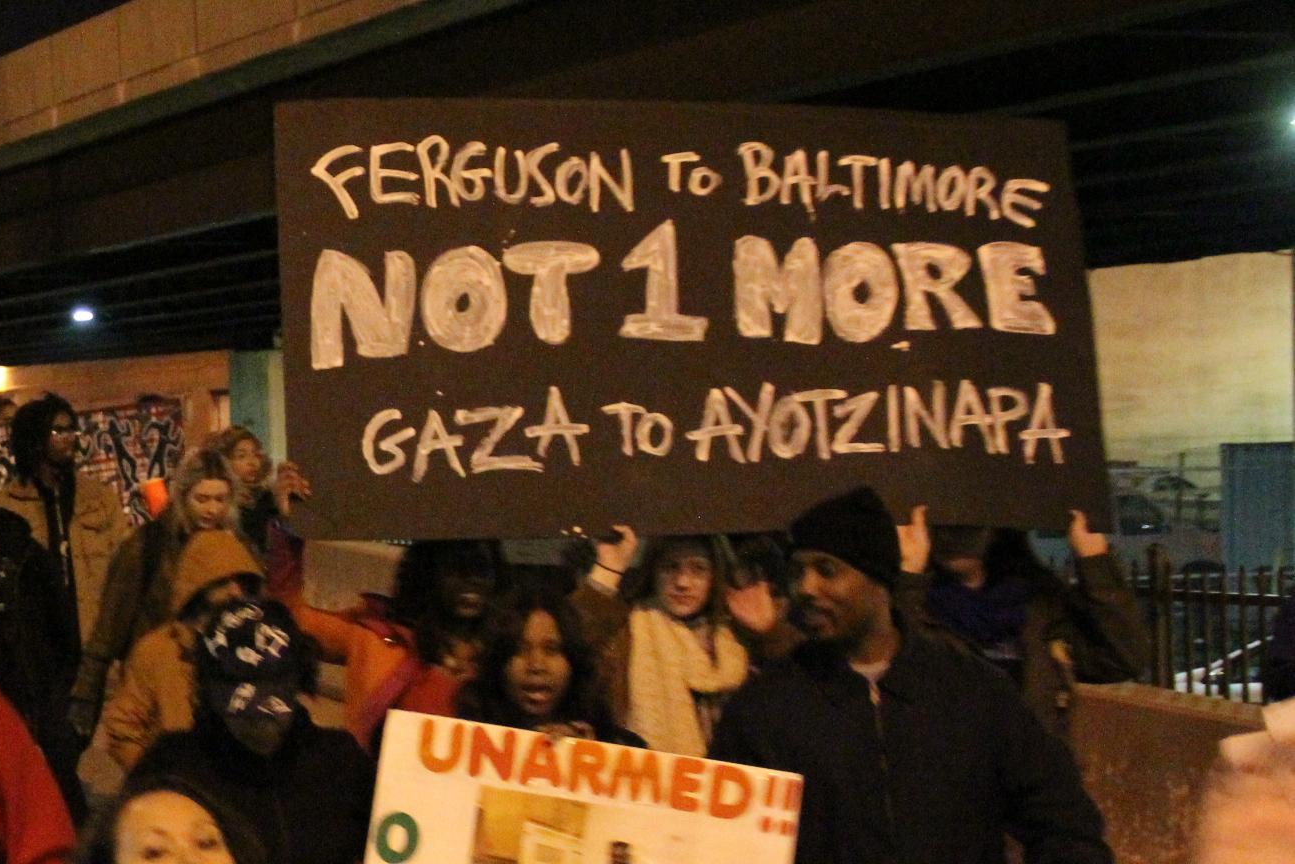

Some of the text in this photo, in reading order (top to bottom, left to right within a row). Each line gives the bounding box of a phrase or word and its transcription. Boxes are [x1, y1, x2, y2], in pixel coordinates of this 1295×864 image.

[311, 135, 634, 219] FERGUSON
[736, 141, 1051, 228] BALTIMORE
[311, 220, 1057, 369] NOT 1 MORE
[362, 386, 590, 482] GAZA
[686, 380, 1071, 465] AYOTZINAPA
